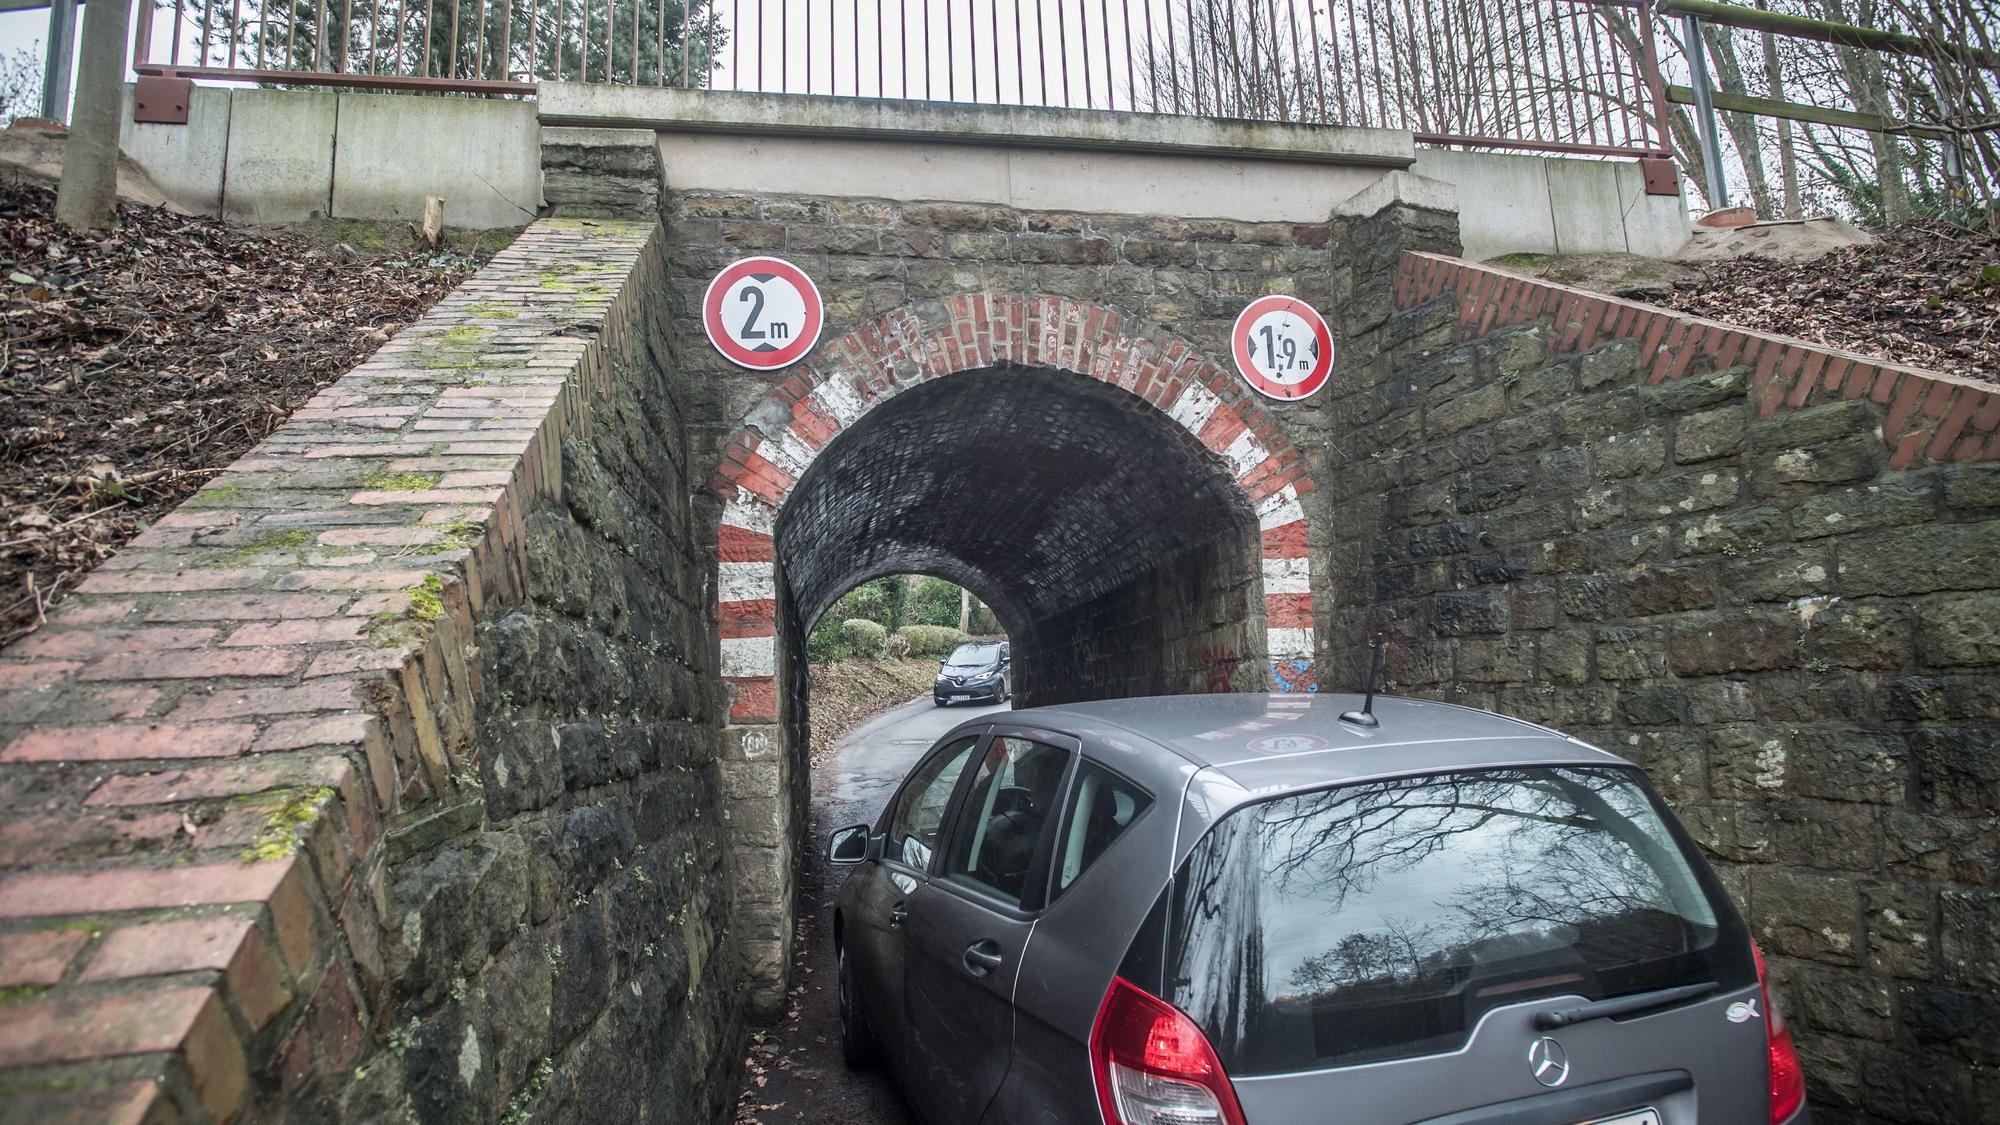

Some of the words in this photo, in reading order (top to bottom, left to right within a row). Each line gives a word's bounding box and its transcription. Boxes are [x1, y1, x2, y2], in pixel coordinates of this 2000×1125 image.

[740, 286, 765, 339] 2
[770, 322, 788, 339] m
[1299, 360, 1309, 370] m
